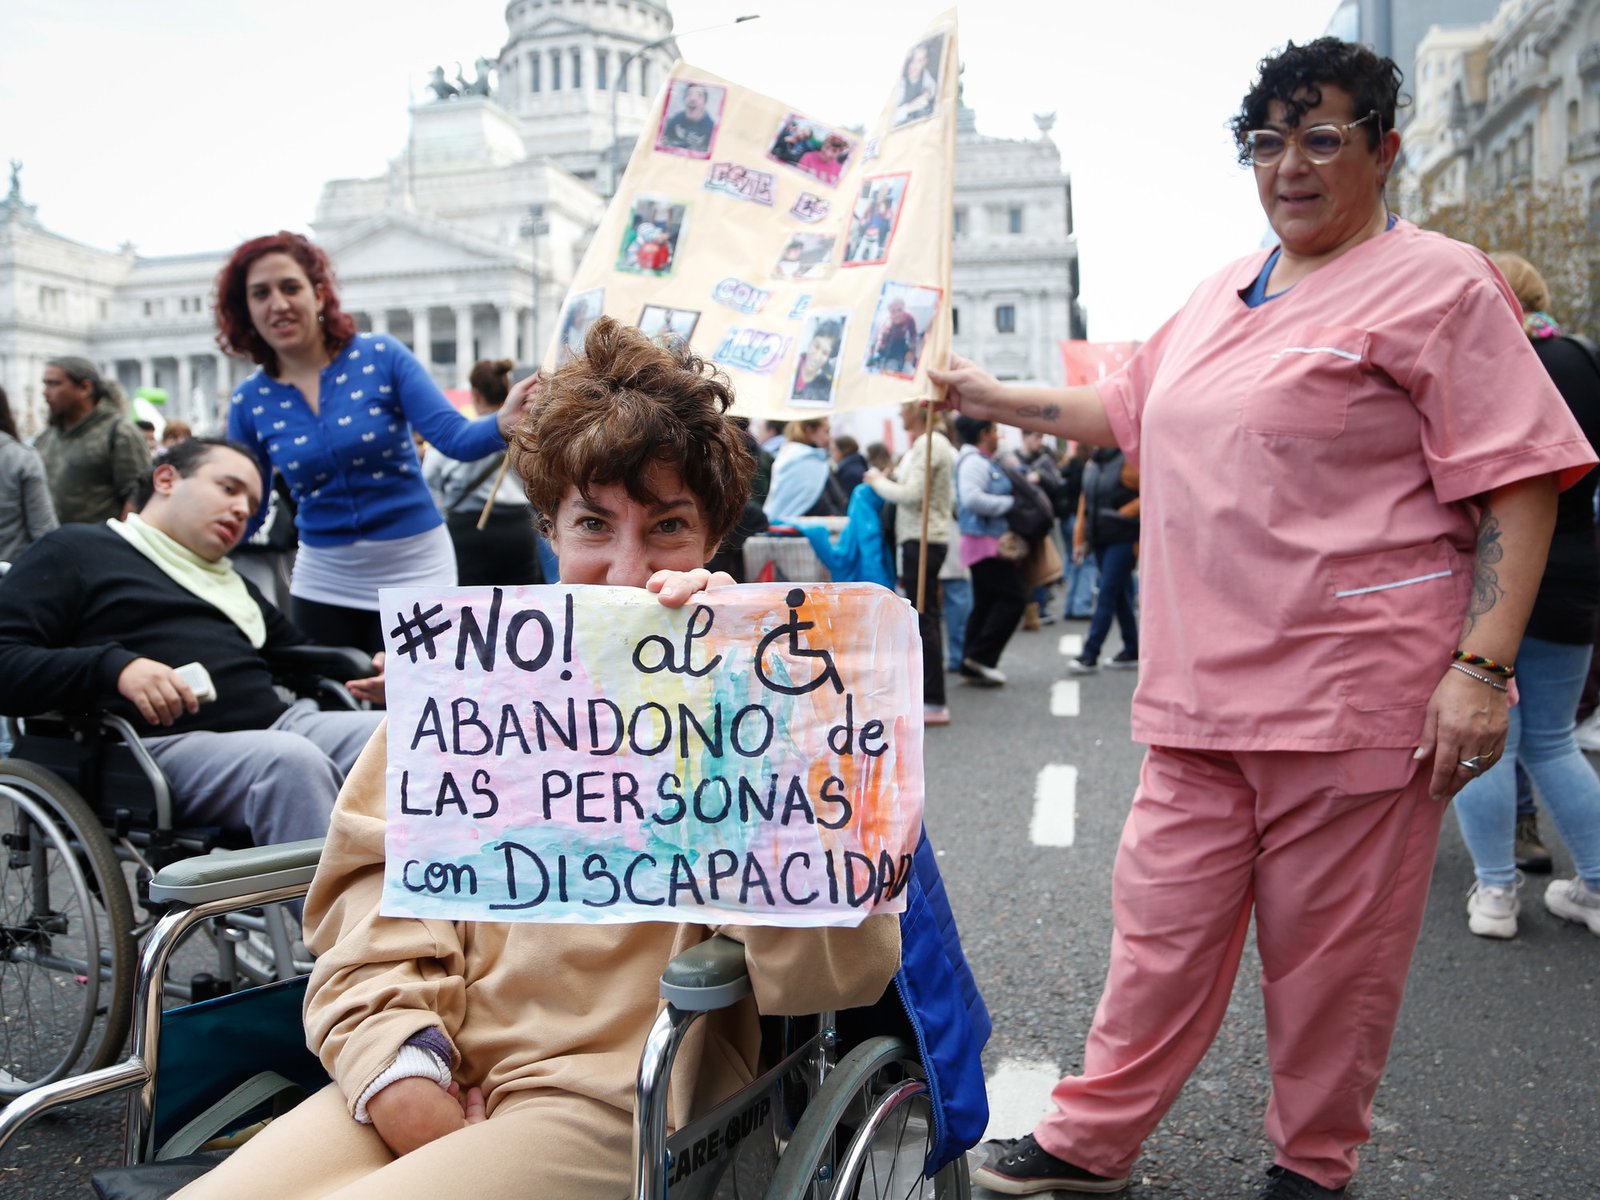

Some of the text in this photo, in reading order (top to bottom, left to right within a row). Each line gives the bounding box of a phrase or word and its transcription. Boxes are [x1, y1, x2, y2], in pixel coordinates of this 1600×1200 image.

[704, 162, 774, 207] ESTE
[712, 277, 769, 314] CON
[390, 586, 723, 681] #NO! al
[410, 692, 889, 759] ABANDONO de
[400, 769, 853, 830] LAS PERSONAS
[402, 841, 912, 910] con DISCAPACIDAD
